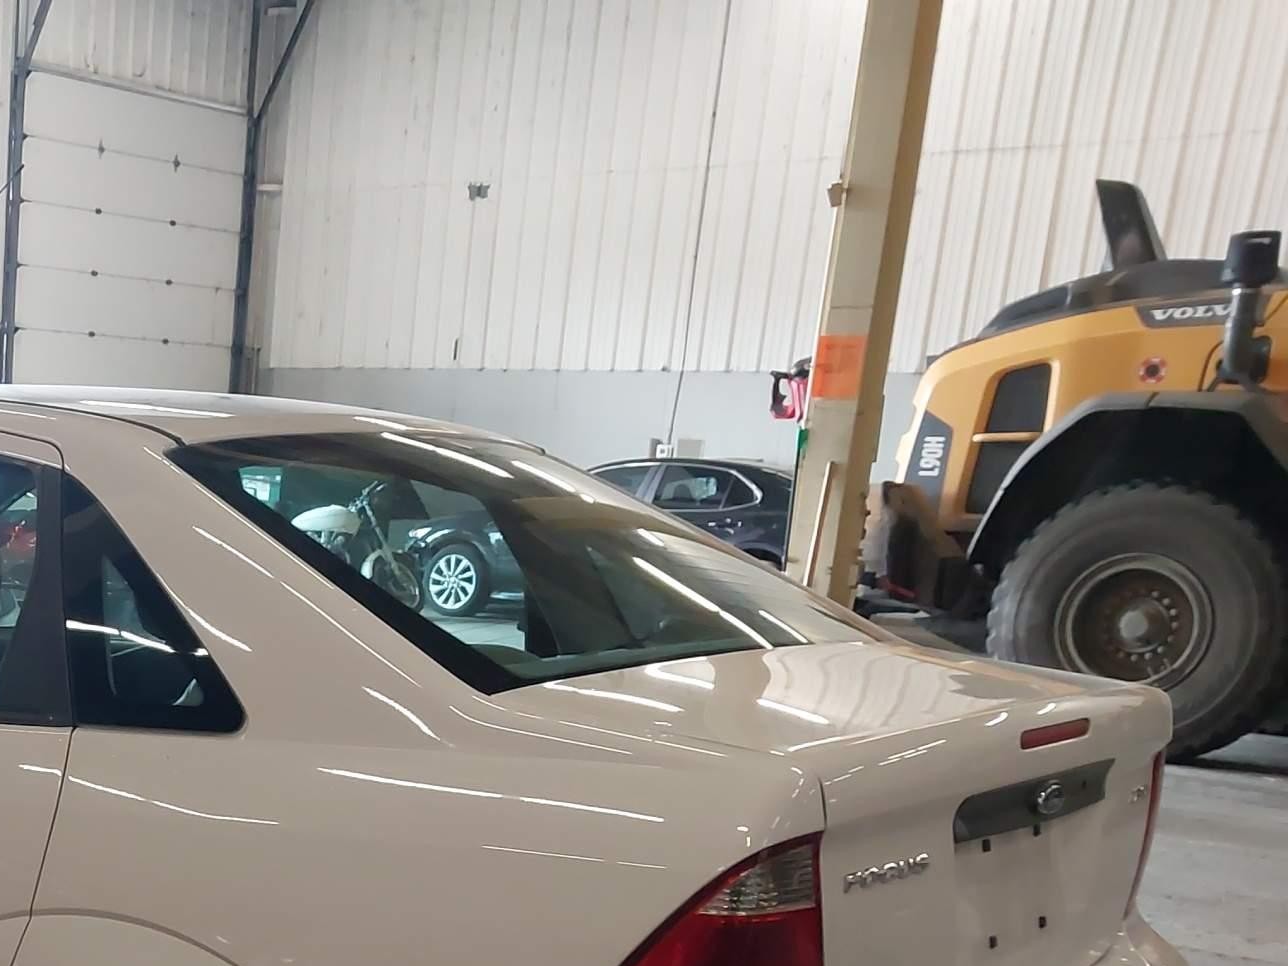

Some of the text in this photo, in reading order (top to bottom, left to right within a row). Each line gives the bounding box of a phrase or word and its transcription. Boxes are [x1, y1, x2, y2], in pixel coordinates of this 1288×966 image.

[1150, 304, 1234, 321] VOLV
[918, 436, 946, 476] L90H
[843, 853, 930, 893] FOCUS
